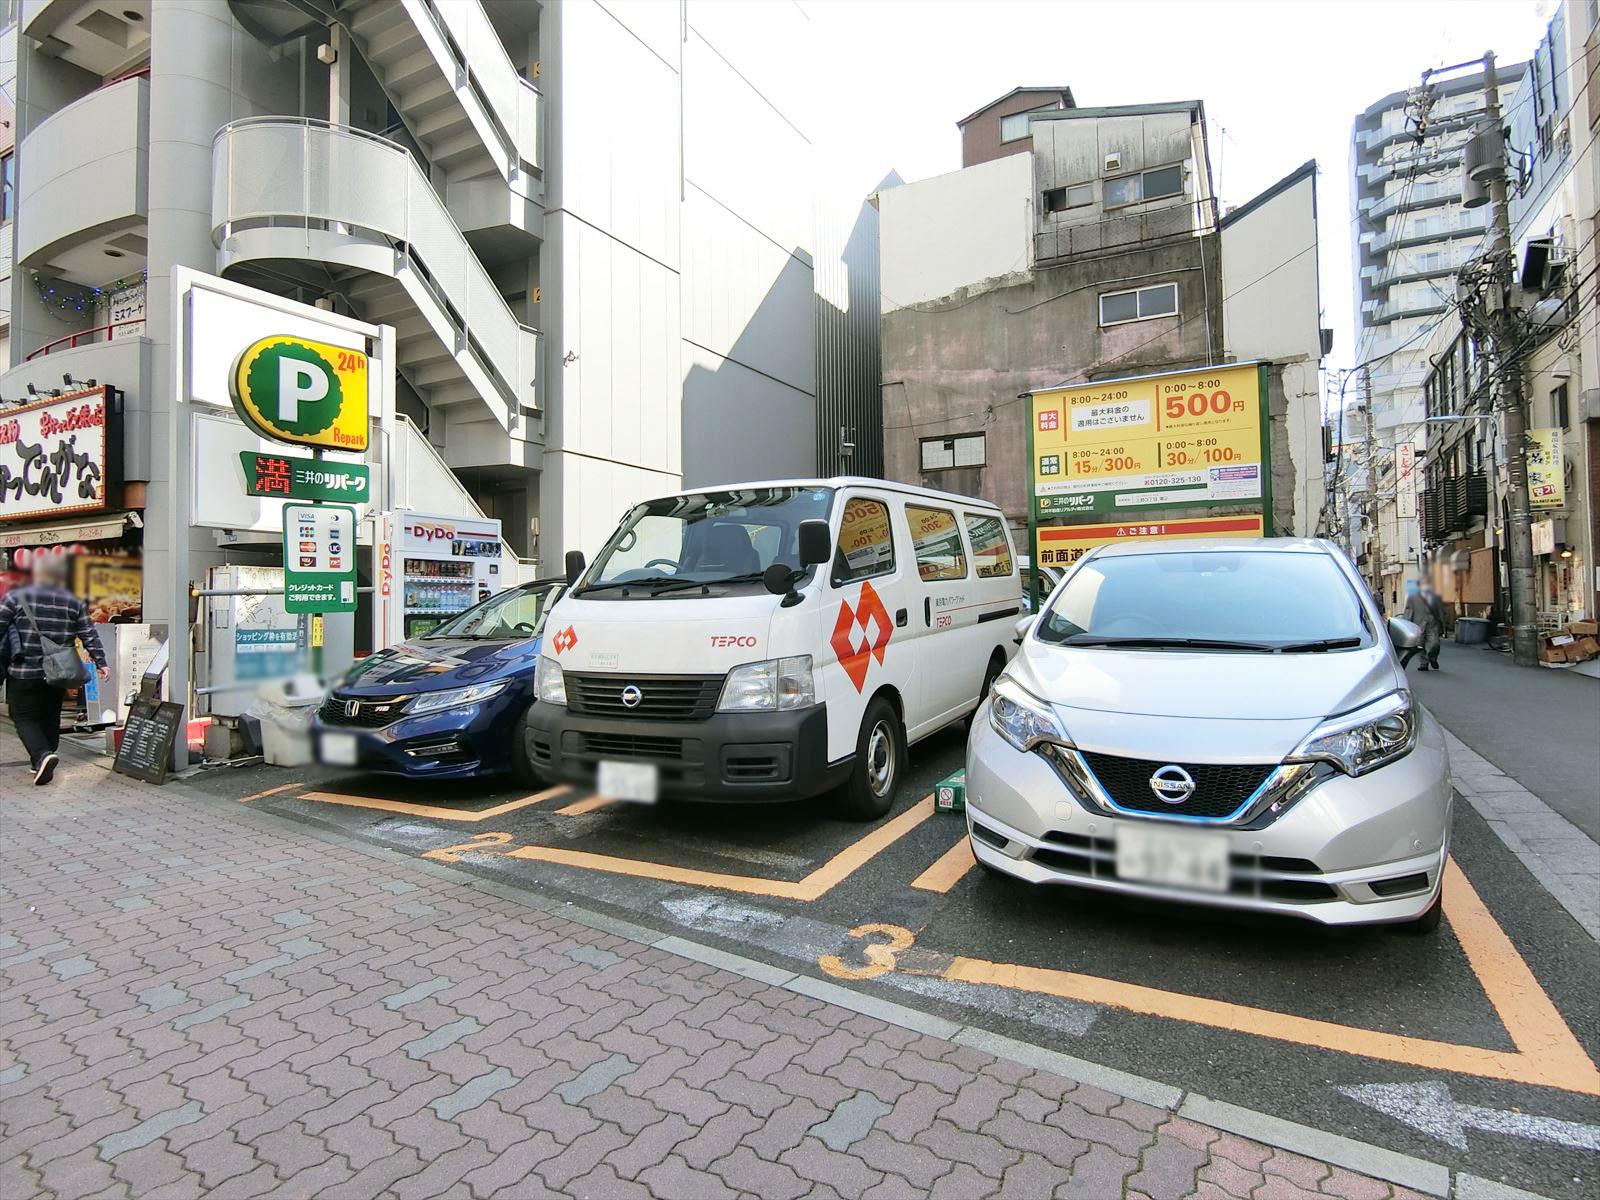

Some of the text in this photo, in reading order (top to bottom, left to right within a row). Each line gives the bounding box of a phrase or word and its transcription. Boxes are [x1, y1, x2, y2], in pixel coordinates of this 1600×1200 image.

[278, 355, 330, 423] P
[1091, 405, 1130, 417] 最大料金の
[1077, 414, 1145, 428] 適用はございません
[333, 426, 365, 446] Repark
[256, 457, 292, 494] 満
[295, 470, 366, 492] 三井のリパーク
[1053, 495, 1095, 506] 三井のリパーク
[300, 512, 316, 520] VISA
[413, 525, 455, 541] DyDo
[1041, 547, 1091, 562] 前面道
[381, 543, 392, 596] DyDo
[288, 584, 335, 592] クレジットカード
[288, 593, 337, 601] ご利用できます。
[936, 615, 952, 629] TEPCO
[711, 636, 757, 648] TEPCO
[1152, 780, 1193, 791] NISSAN
[817, 922, 916, 981] 3
